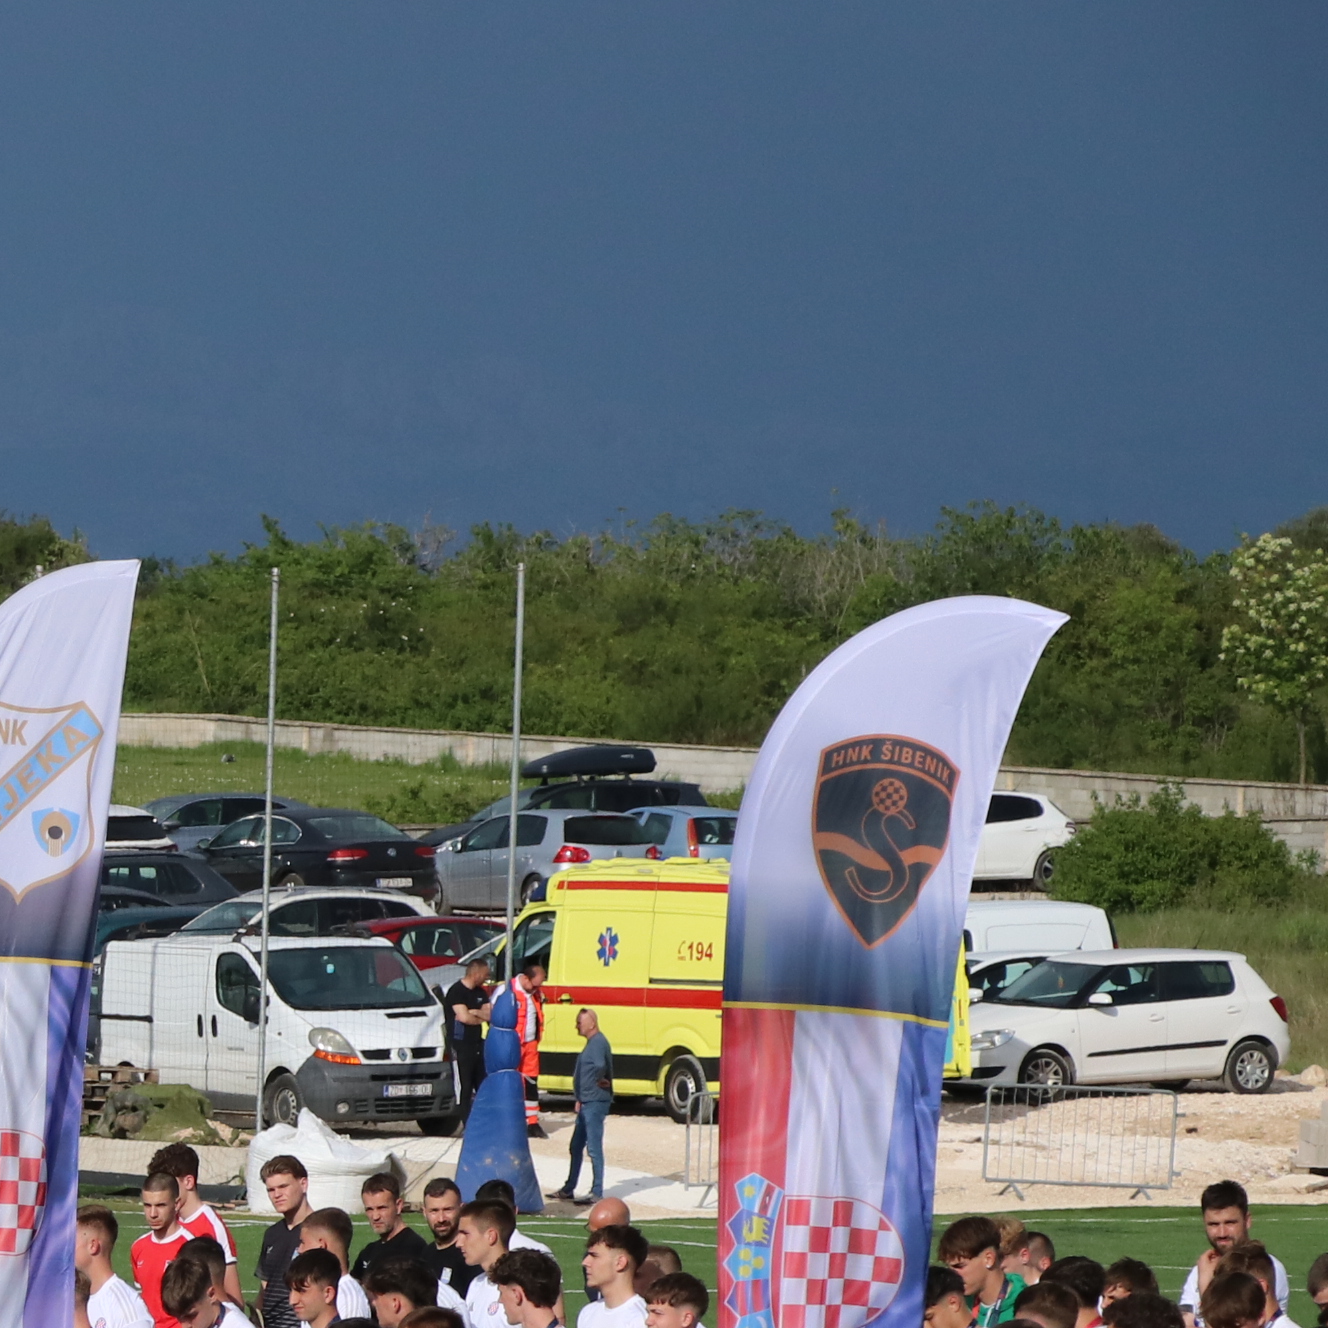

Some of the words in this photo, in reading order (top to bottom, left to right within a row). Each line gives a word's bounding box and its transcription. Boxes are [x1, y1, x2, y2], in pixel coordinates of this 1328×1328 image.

[831, 744, 874, 768] HNK
[880, 741, 951, 784] ŠIBENIK
[688, 941, 714, 961] 194
